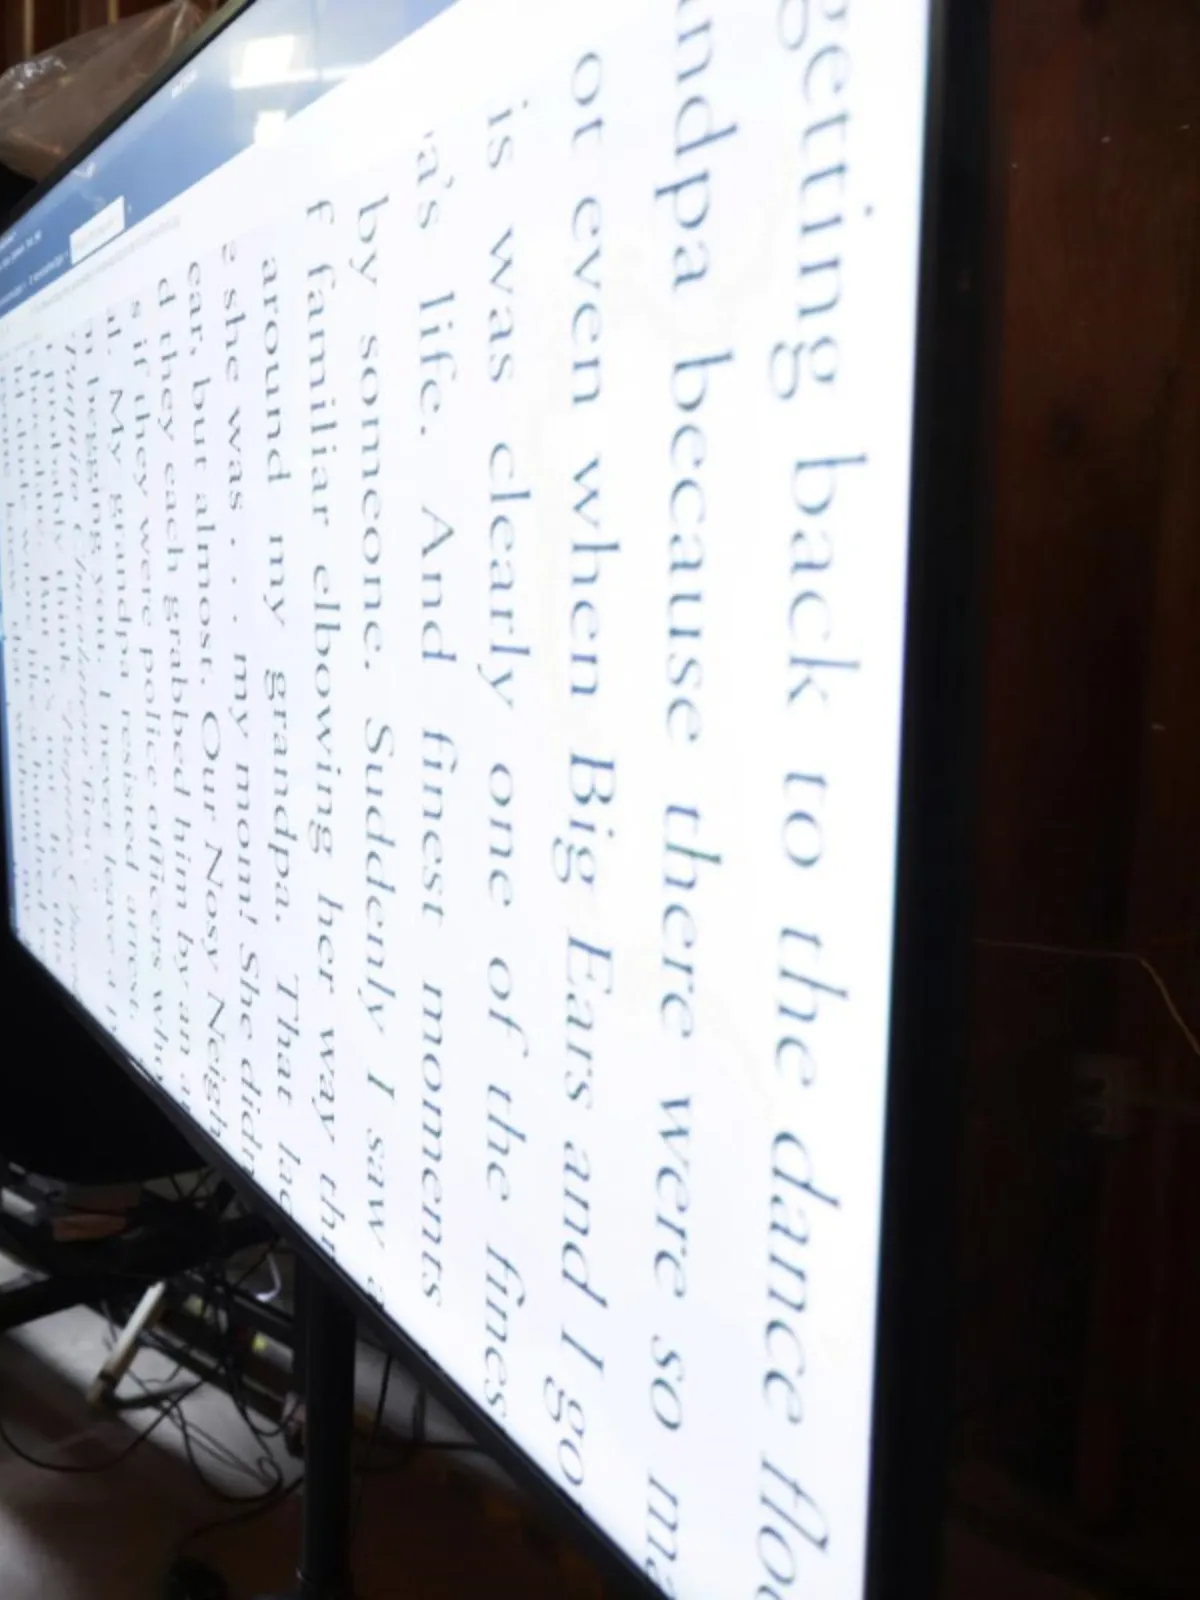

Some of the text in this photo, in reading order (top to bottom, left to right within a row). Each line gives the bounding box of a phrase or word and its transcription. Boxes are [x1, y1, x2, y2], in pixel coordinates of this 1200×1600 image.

[487, 99, 529, 170] is
[770, 0, 874, 401] getting
[348, 194, 390, 286] by
[488, 226, 514, 384] was
[571, 195, 602, 406] even
[132, 338, 148, 368] if
[157, 331, 179, 442] they
[223, 287, 247, 383] she
[261, 257, 292, 484] around
[306, 263, 339, 527] familiar
[418, 290, 457, 437] life.
[107, 388, 125, 465] My
[133, 393, 152, 497] they
[192, 376, 212, 467] but
[227, 406, 243, 512] was
[139, 516, 152, 627] were
[163, 461, 185, 573] each
[360, 334, 383, 671] someone.
[666, 349, 735, 743] because
[108, 492, 134, 679] grandpa
[195, 493, 217, 685] almost.
[262, 534, 286, 627] my
[420, 505, 458, 663] And
[476, 441, 532, 708] clearly
[569, 456, 622, 697] when
[787, 452, 869, 704] back
[138, 647, 162, 787] police
[162, 594, 192, 798] grabbed
[201, 710, 221, 822] Our
[227, 652, 249, 740] my
[308, 563, 343, 856] elbowing
[173, 816, 192, 910] him
[235, 762, 259, 926] mom!
[263, 668, 299, 923] grandpa.
[421, 726, 459, 927] finest
[487, 762, 514, 908] one
[551, 750, 617, 893] Big
[783, 771, 829, 870] to
[147, 803, 166, 969] officers
[200, 840, 225, 972] Nosy
[317, 892, 345, 995] her
[356, 716, 397, 1034] Suddenly
[659, 803, 723, 1039] there
[173, 929, 195, 989] by
[178, 1000, 191, 1056] an
[238, 942, 261, 1041] She
[487, 956, 530, 1059] of
[564, 935, 613, 1110] Ears
[774, 926, 849, 1088] the
[202, 991, 229, 1139] Neigh
[276, 974, 301, 1105] That
[310, 1027, 336, 1145] way
[366, 1071, 396, 1101] I
[366, 1127, 385, 1249] saw
[420, 979, 444, 1307] moments
[486, 1083, 528, 1203] the
[653, 1095, 692, 1299] were
[560, 1139, 609, 1310] and
[762, 1130, 842, 1426] dance
[560, 1327, 605, 1373] I
[650, 1334, 684, 1433] so
[543, 1374, 585, 1488] go
